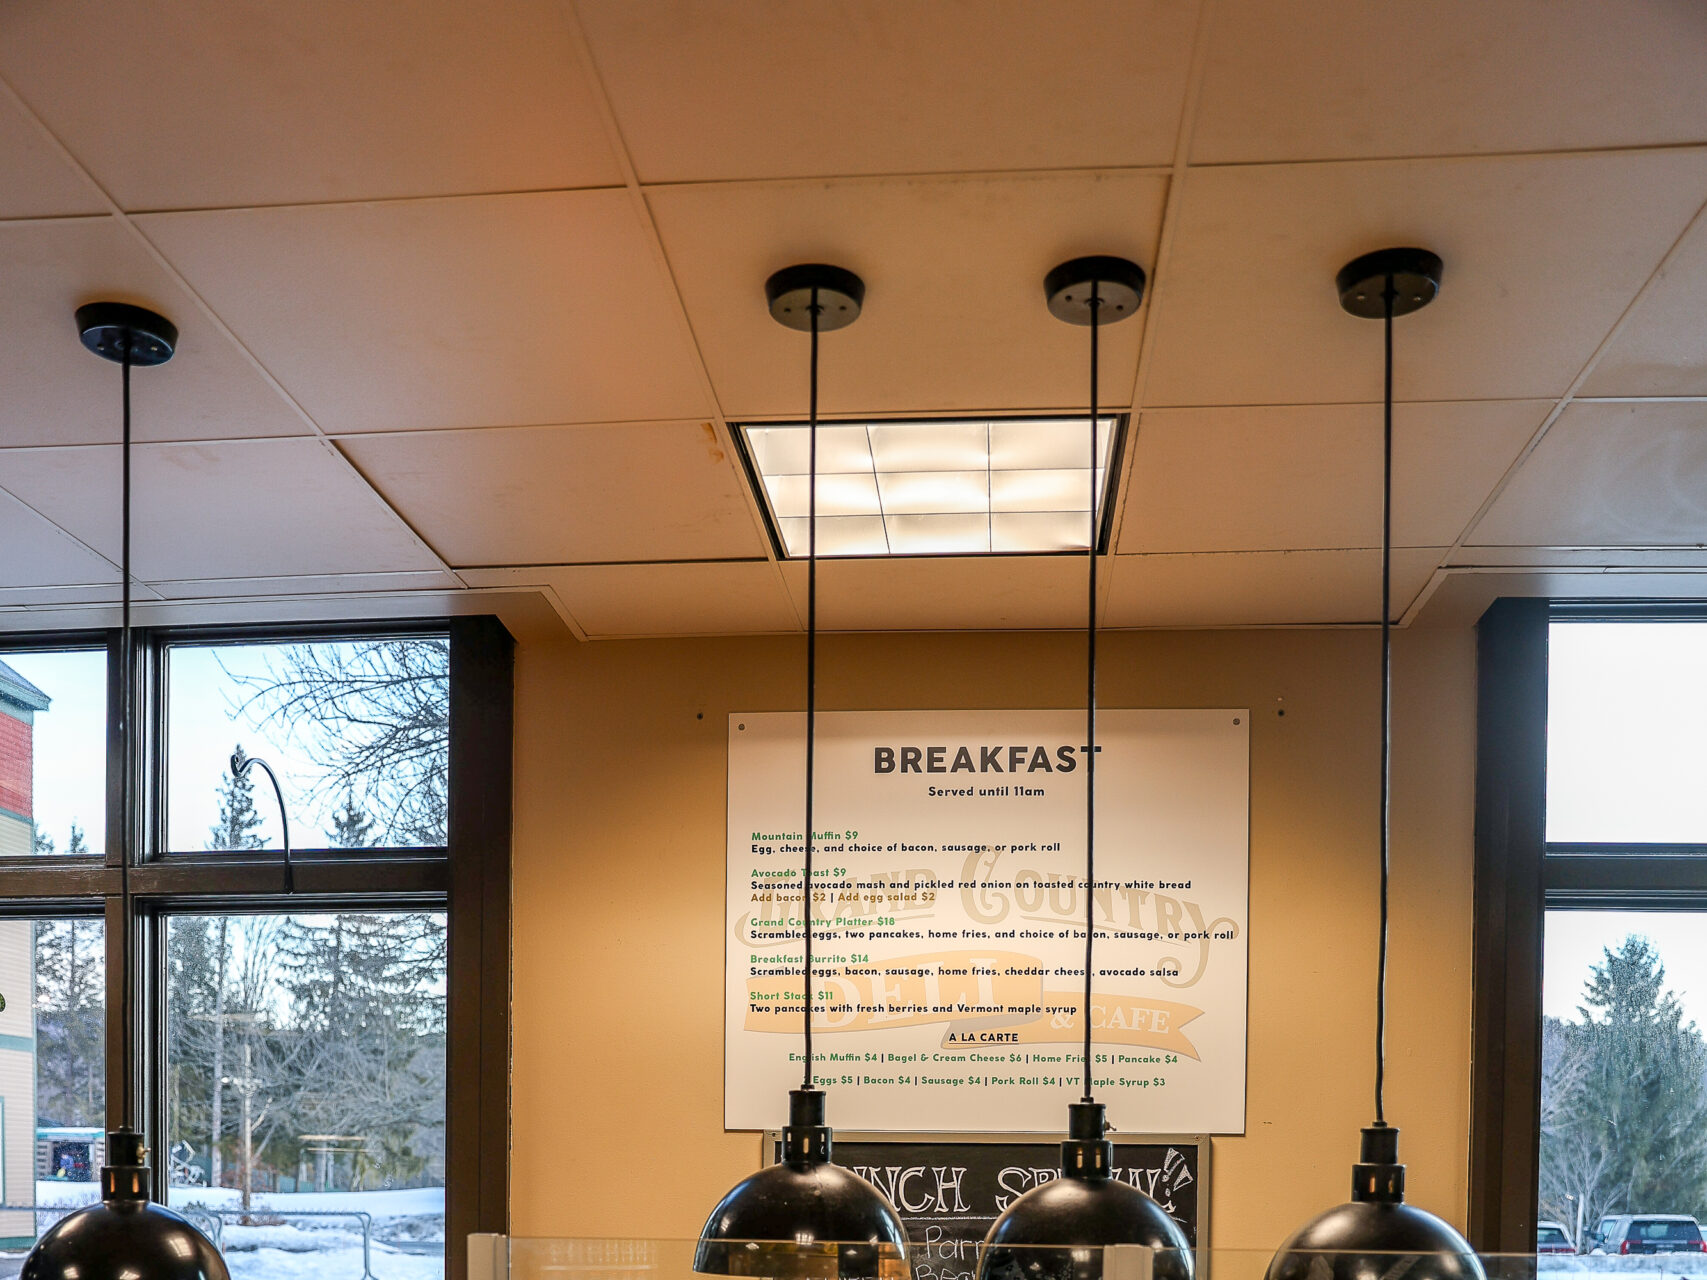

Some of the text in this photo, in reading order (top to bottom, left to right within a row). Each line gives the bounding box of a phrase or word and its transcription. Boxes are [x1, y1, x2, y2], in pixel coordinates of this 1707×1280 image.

[874, 745, 1103, 774] BREAKFAST
[928, 785, 1045, 797] Served until 11am
[751, 831, 803, 841] Mountain
[845, 830, 859, 841] $9
[751, 842, 1061, 855] Egg, cheee, and choice of bacon, sausage, or pork roll
[751, 867, 847, 878] Avocado Tast $9
[750, 880, 803, 891] Seasoned
[856, 879, 886, 889] mash
[889, 879, 910, 889] and
[914, 879, 954, 891] pickled
[958, 879, 977, 889] red
[980, 879, 1012, 889] onion
[1015, 881, 1030, 889] on
[1033, 879, 1074, 889] toasted
[1124, 879, 1155, 889] white
[1158, 880, 1192, 889] bread
[750, 893, 772, 902] Add
[812, 891, 826, 903] $2
[837, 892, 859, 902] Add
[863, 894, 883, 904] egg
[887, 892, 917, 901] salad
[921, 891, 935, 902] $2
[750, 917, 784, 927] Grand
[835, 917, 873, 926] Platter
[877, 916, 895, 927] $18
[812, 930, 841, 941] eggs,
[845, 930, 865, 939] two
[868, 929, 924, 941] pancakes,
[928, 929, 958, 939] home
[961, 929, 991, 940] fries,
[994, 929, 1016, 939] and
[1019, 929, 1055, 939] choice
[1058, 929, 1070, 939] of
[1073, 929, 1110, 940] baon,
[1113, 932, 1164, 942] sausage,
[1167, 932, 1180, 940] or
[1183, 929, 1210, 942] pork
[1214, 930, 1234, 940] roll
[750, 954, 803, 964] Breakfast
[850, 953, 869, 964] $14
[811, 968, 841, 978] eggs,
[844, 966, 881, 978] bacon,
[885, 968, 934, 978] sausage,
[938, 966, 968, 976] home
[971, 966, 1001, 978] fries,
[1004, 966, 1051, 976] cheddar
[1054, 966, 1095, 977] chees,
[1099, 967, 1146, 977] avocado
[1149, 967, 1179, 977] salsa
[750, 991, 780, 1001] Short
[818, 990, 833, 1001] $11
[749, 1003, 771, 1013] Two
[829, 1003, 853, 1013] with
[856, 1003, 885, 1013] fresh
[888, 1003, 929, 1013] berries
[932, 1003, 953, 1013] and
[956, 1003, 1004, 1013] Vermont
[1007, 1003, 1042, 1016] maple
[1045, 1006, 1077, 1016] syrup
[948, 1032, 1019, 1042] A LA CARTE
[788, 1052, 826, 1064] Engish
[829, 1052, 861, 1062] Muffin
[864, 1052, 878, 1063] $4
[887, 1053, 917, 1064] Bagel
[920, 1053, 929, 1062] &
[932, 1053, 966, 1062] Cream
[969, 1053, 1006, 1062] Cheese
[1009, 1052, 1022, 1063] $6
[1032, 1054, 1062, 1063] Home
[1065, 1054, 1087, 1063] Frie
[1095, 1053, 1108, 1064] $5
[1118, 1054, 1161, 1064] Pancake
[1164, 1054, 1178, 1065] $4
[813, 1075, 838, 1086] Eggs
[840, 1075, 853, 1085] $5
[863, 1075, 895, 1085] Bacon
[898, 1075, 911, 1085] $4
[921, 1075, 964, 1087] Sausage
[967, 1075, 981, 1086] $4
[991, 1076, 1015, 1085] Pork
[1019, 1076, 1039, 1085] Roll
[1042, 1076, 1056, 1086] $4
[1065, 1077, 1081, 1086] VT
[1090, 1076, 1115, 1088] aple
[1118, 1077, 1150, 1089] Syrup
[1153, 1077, 1166, 1087] $3
